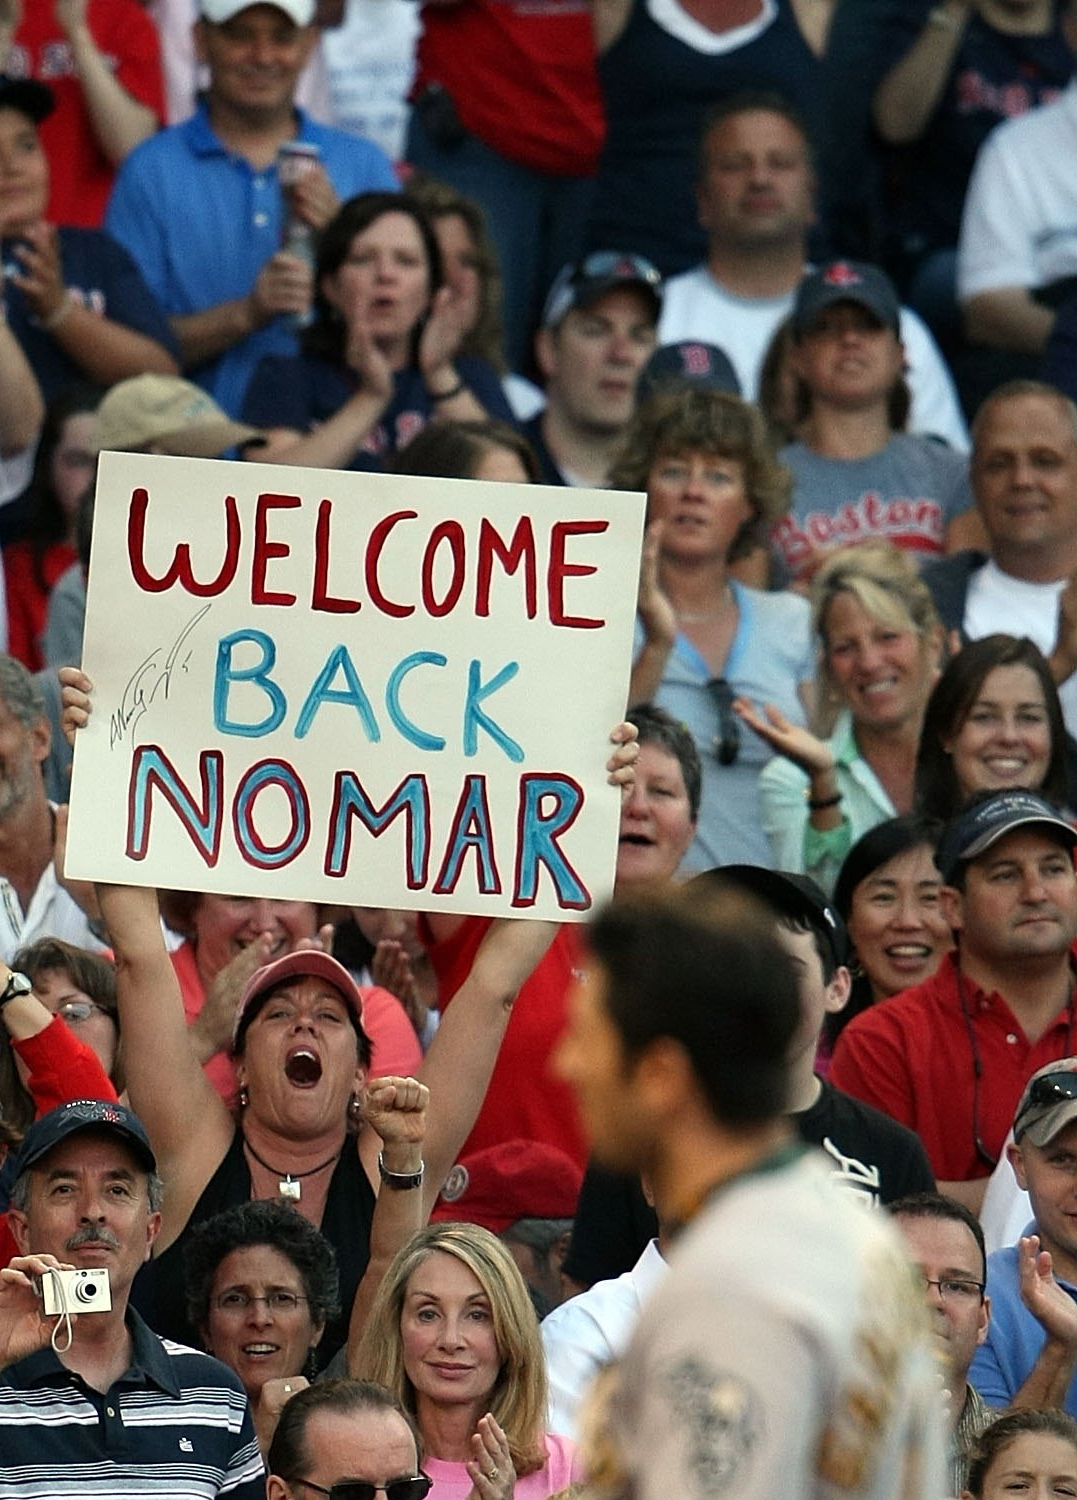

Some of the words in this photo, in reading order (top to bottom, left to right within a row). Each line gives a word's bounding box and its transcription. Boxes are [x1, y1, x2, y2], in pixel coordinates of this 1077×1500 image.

[128, 487, 610, 629] WELCOME
[770, 491, 944, 564] Boston
[213, 628, 525, 764] BACK
[124, 744, 593, 910] NOMAR
